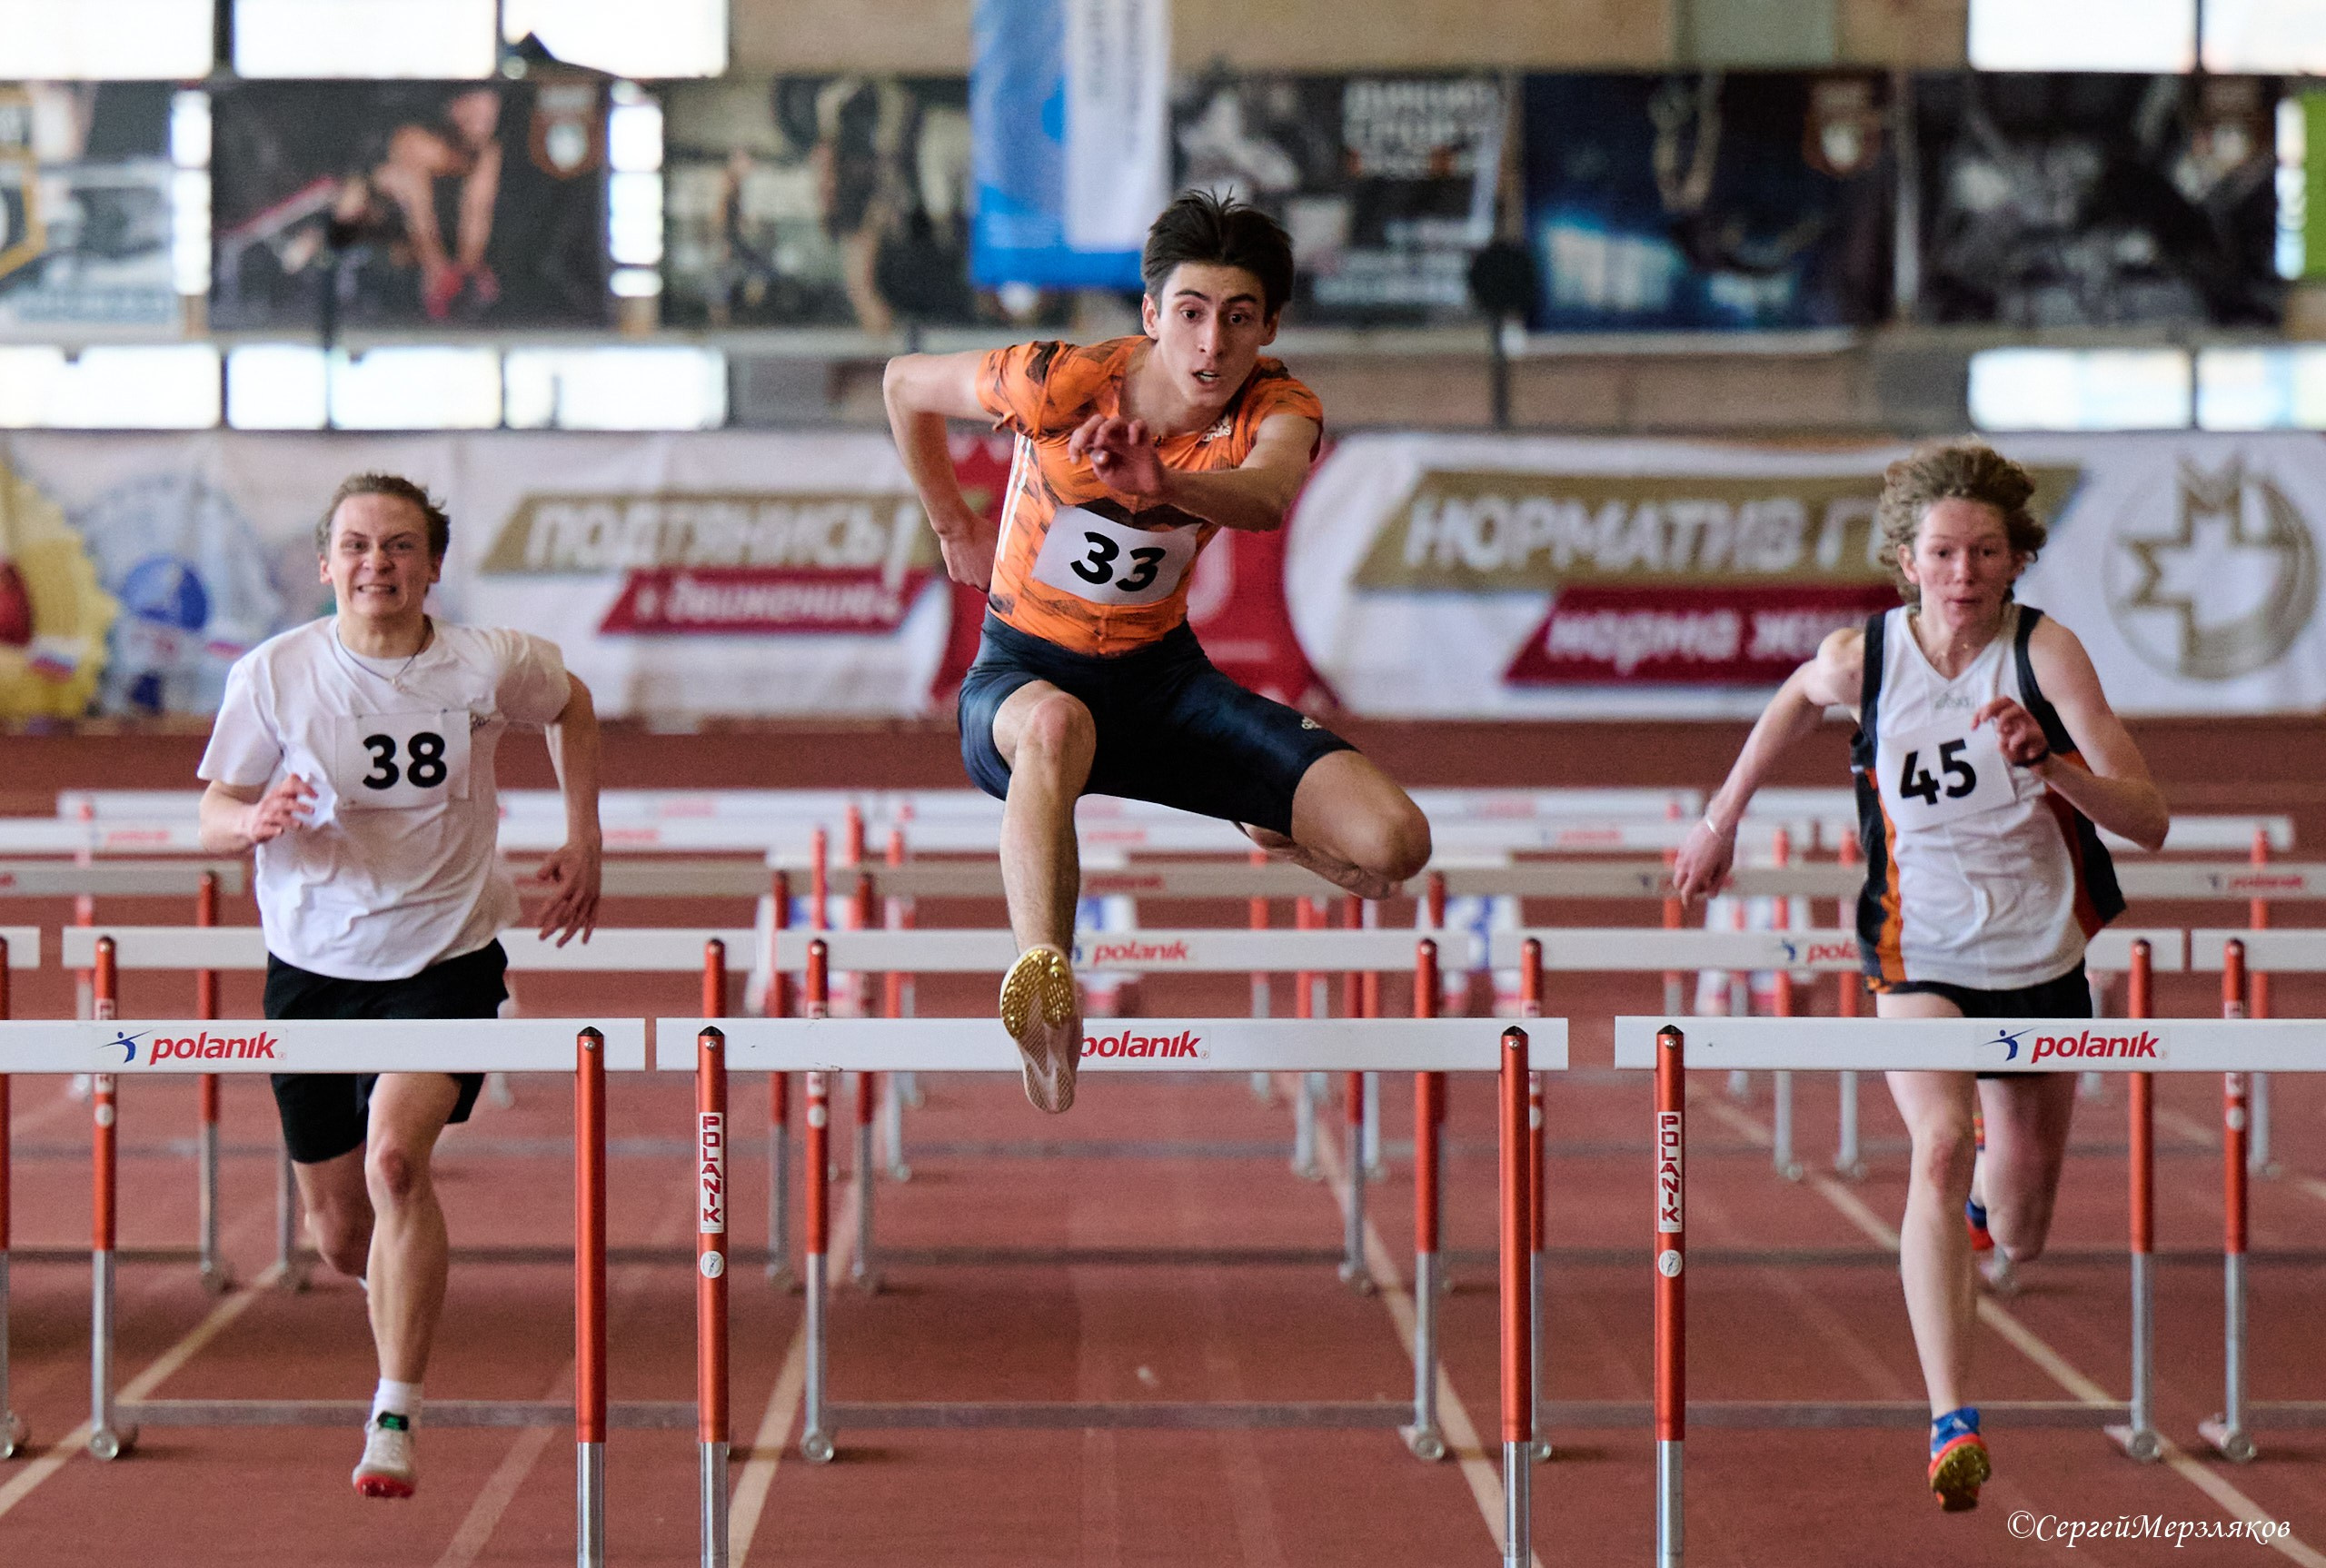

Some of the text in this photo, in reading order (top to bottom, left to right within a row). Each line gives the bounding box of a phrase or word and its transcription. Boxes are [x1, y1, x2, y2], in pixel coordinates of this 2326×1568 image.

[1070, 531, 1166, 591] 33
[1404, 496, 1806, 572] НОРМАТИВ
[1546, 610, 1740, 674] норма
[363, 731, 447, 789] 38
[1900, 738, 1976, 806] 45
[1093, 940, 1188, 966] polanik
[1805, 938, 1861, 965] pola
[148, 1031, 278, 1066] polanik
[2031, 1029, 2159, 1064] polanik
[702, 1116, 722, 1223] POLANIK
[1660, 1115, 1680, 1223] POLANIK
